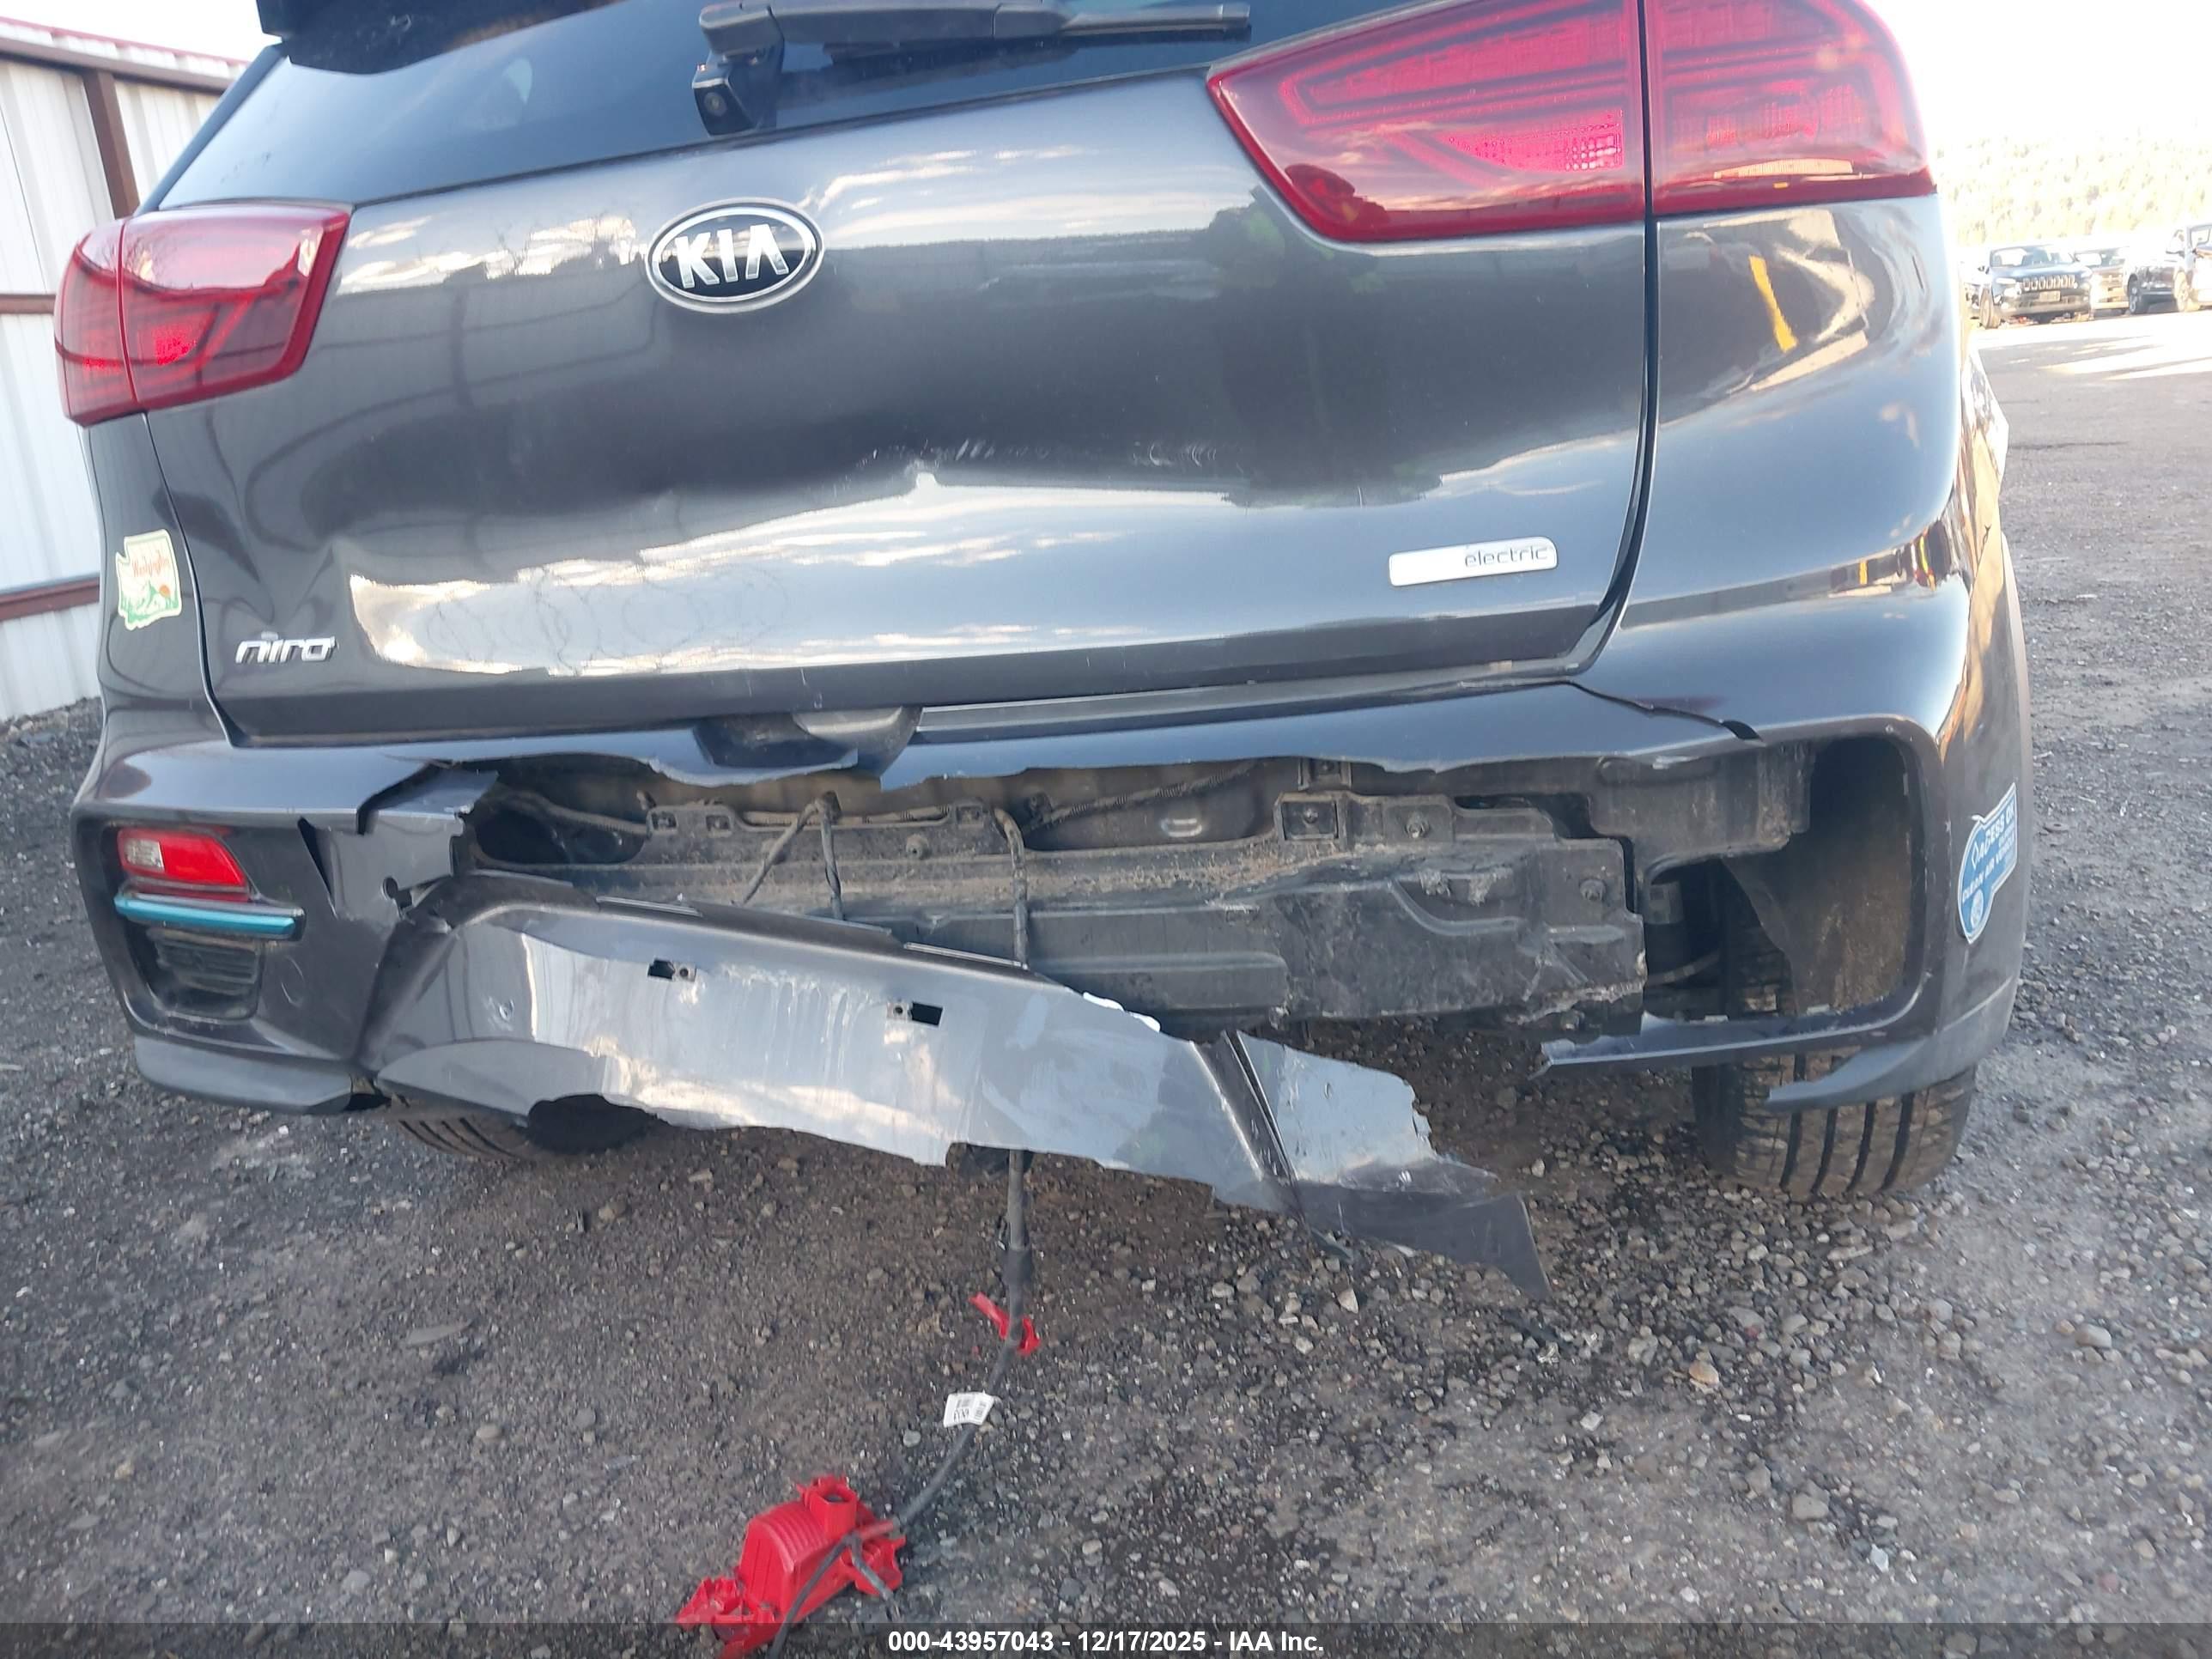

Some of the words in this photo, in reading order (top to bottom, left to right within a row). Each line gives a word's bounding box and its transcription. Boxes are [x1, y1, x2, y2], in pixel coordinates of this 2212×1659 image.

[675, 223, 789, 289] KIA
[1465, 545, 1548, 568] electric
[235, 631, 337, 664] niro
